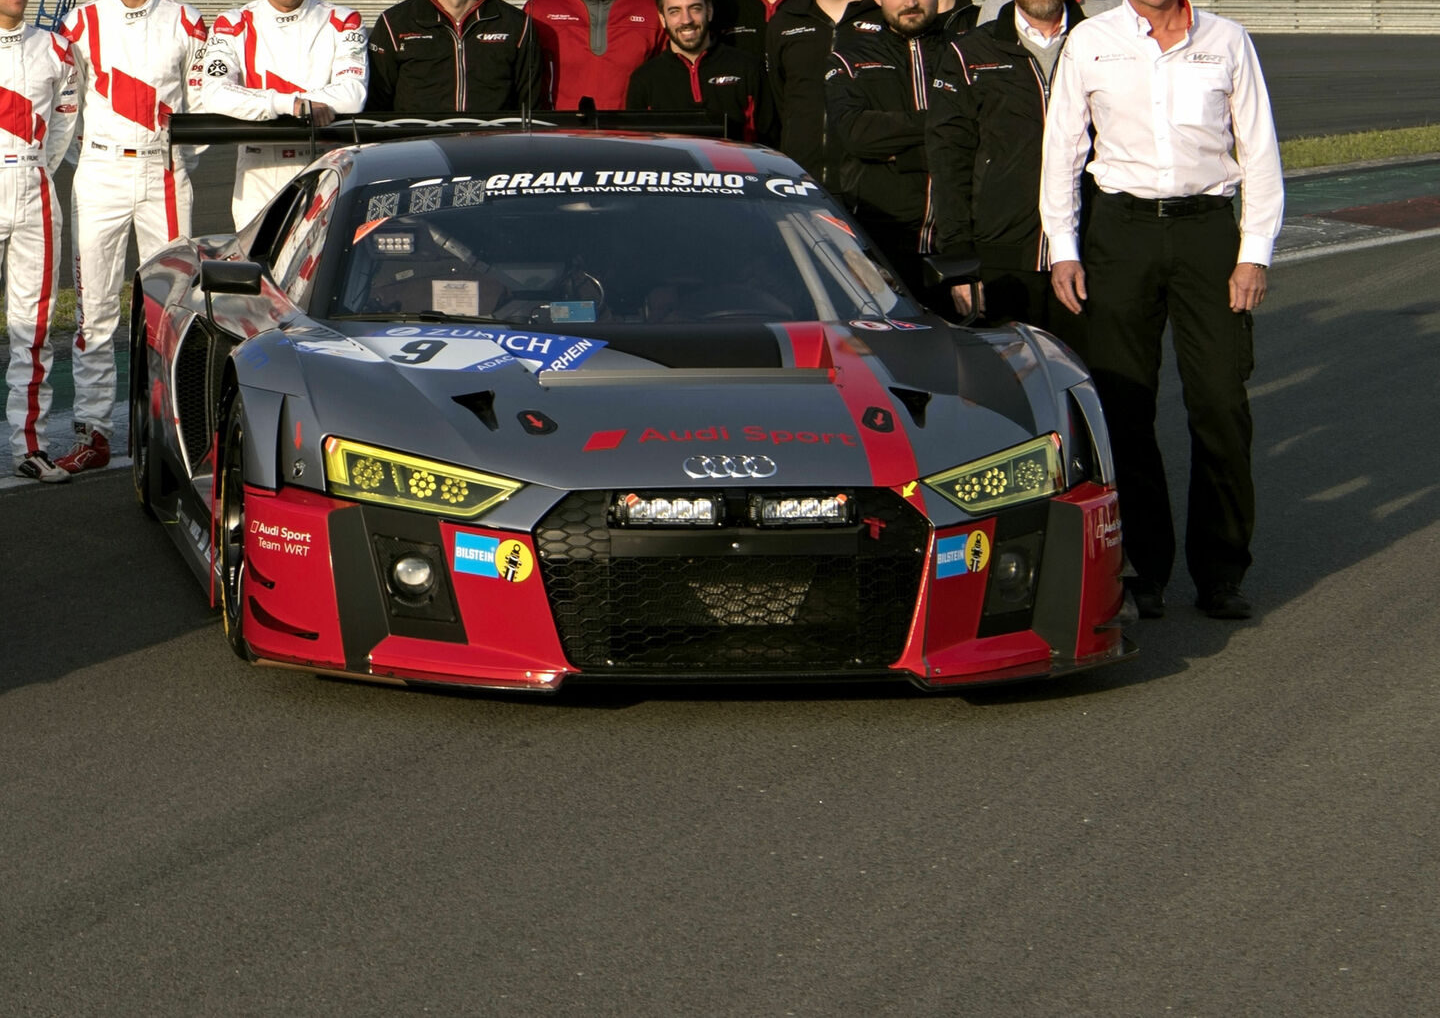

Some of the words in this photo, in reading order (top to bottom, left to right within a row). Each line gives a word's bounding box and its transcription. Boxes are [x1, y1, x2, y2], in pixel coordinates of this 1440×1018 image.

[486, 171, 583, 188] GRAN
[486, 188, 517, 196] THE
[522, 187, 566, 195] REAL
[647, 186, 745, 195] SIMULATOR
[426, 328, 553, 354] ZURICH
[389, 339, 449, 365] 9
[476, 354, 517, 371] ADAC
[638, 426, 731, 443] Audi
[744, 426, 857, 447] Sport
[258, 522, 279, 536] Audi
[281, 526, 311, 542] Sport
[258, 537, 281, 551] Team
[284, 542, 310, 557] WRT
[455, 546, 495, 563] BILSTEIN
[937, 551, 964, 565] BILSTEIN
